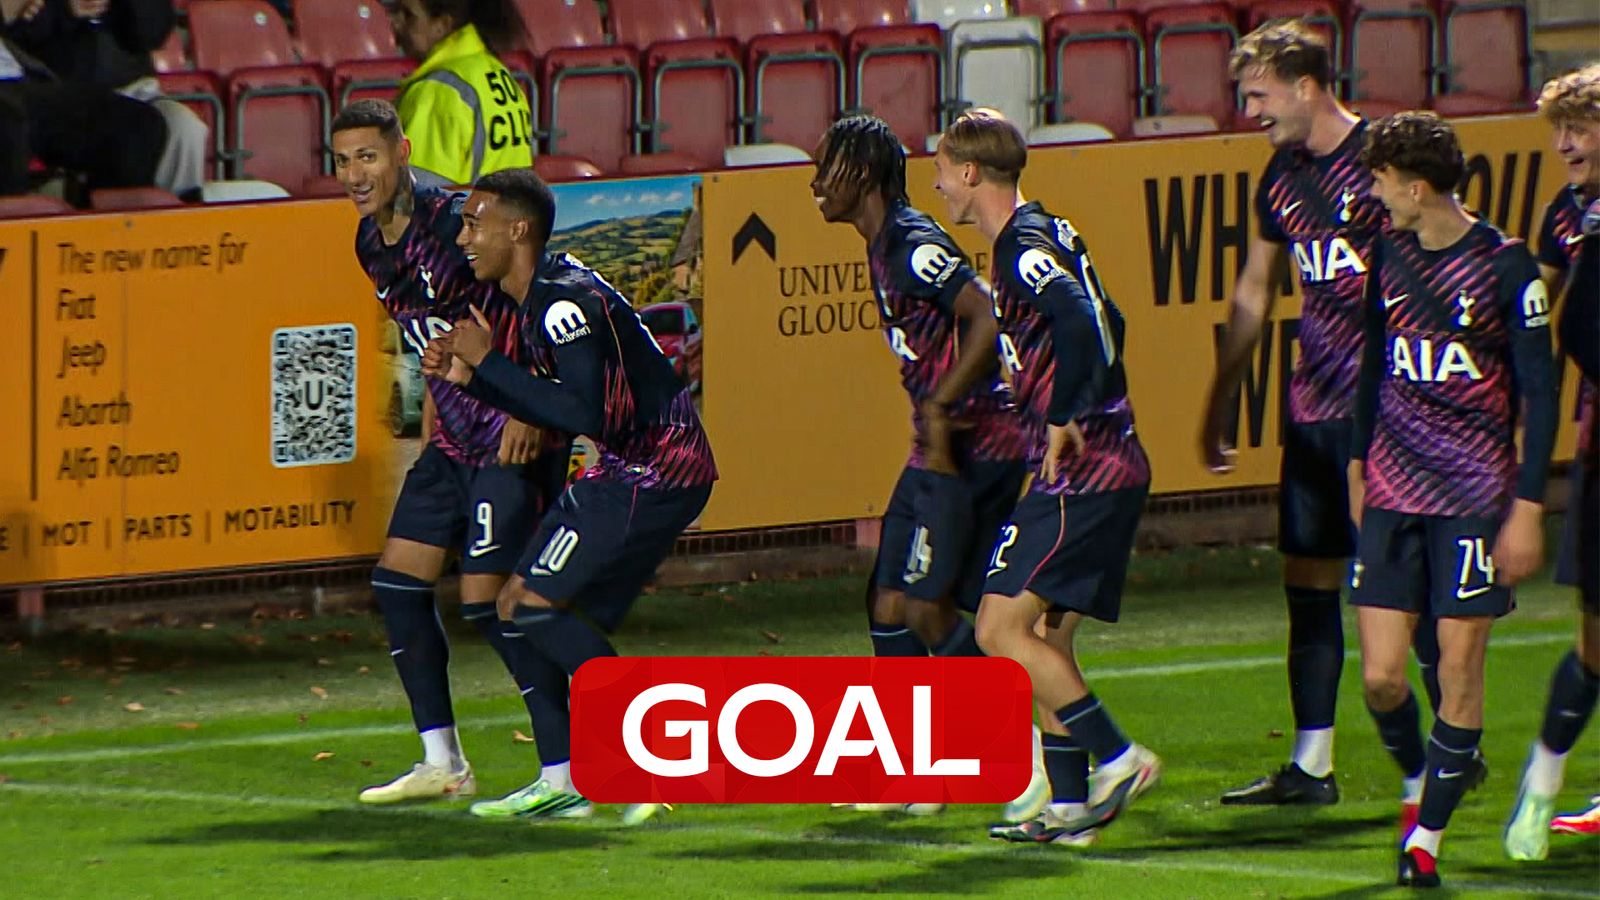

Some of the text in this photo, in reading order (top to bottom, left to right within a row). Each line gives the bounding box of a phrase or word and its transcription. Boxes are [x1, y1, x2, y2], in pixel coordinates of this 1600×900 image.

[489, 109, 531, 150] CLU
[56, 232, 248, 274] The new name for
[1291, 236, 1368, 283] AIA
[778, 262, 875, 297] UNIVE
[56, 288, 97, 321] Fiat
[777, 300, 884, 337] GLOUC
[56, 339, 107, 379] Jeep
[1391, 336, 1482, 382] AIA
[56, 391, 132, 427] Abarth
[57, 446, 181, 487] Alfa Romeo
[41, 520, 94, 547] MOT
[123, 514, 193, 541] PARTS
[225, 500, 357, 532] MOTABILITY
[477, 502, 494, 546] 9
[538, 525, 580, 573] 10
[1458, 537, 1494, 584] 74
